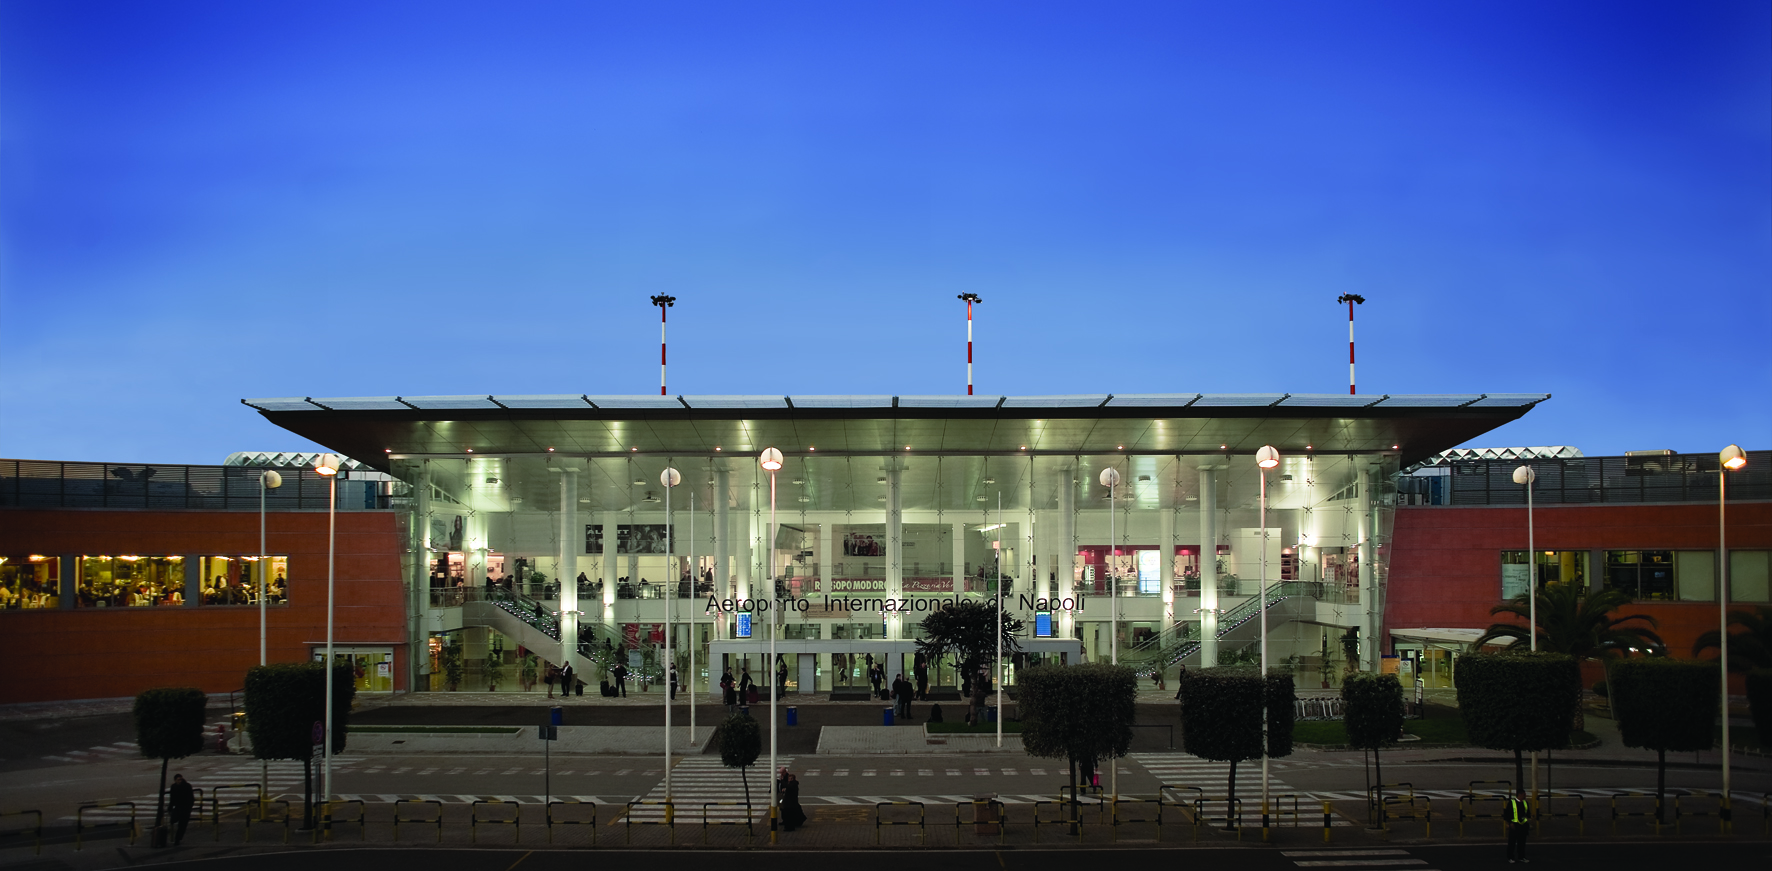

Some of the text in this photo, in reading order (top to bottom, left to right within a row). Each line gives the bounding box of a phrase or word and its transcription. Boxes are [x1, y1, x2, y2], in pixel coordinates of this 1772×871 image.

[814, 580, 887, 590] RSOPOMODOR
[825, 594, 972, 612] Internazionale
[1020, 593, 1085, 616] Napoli
